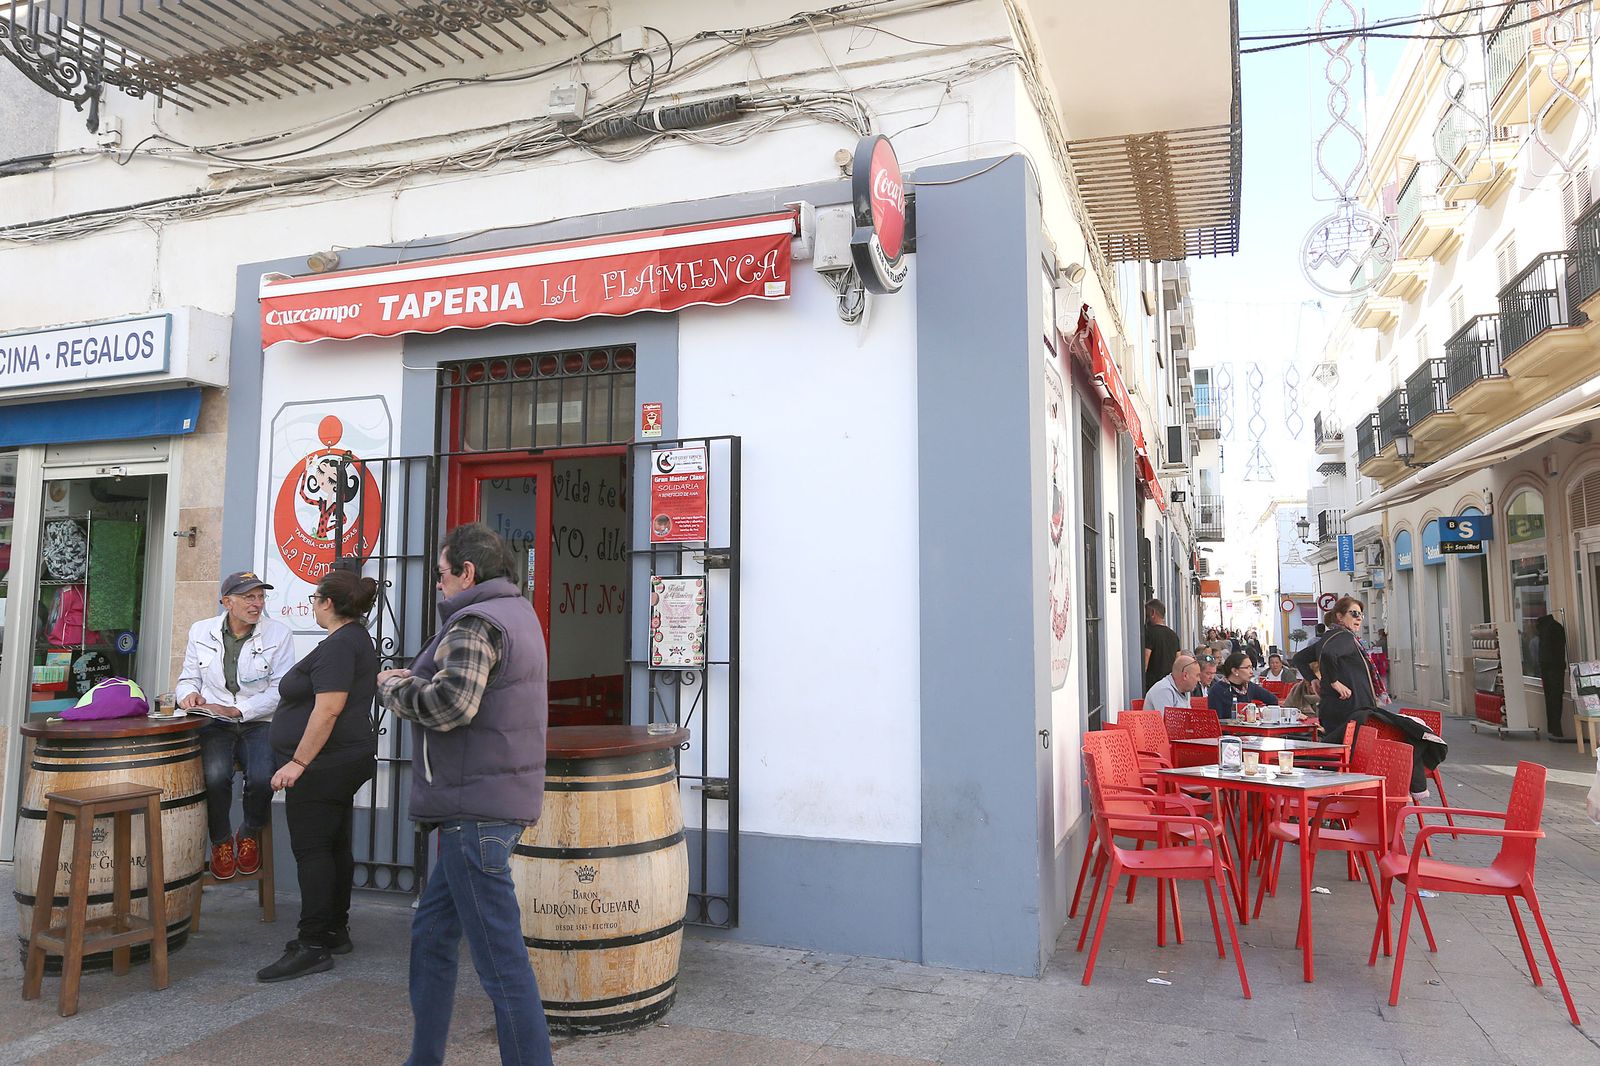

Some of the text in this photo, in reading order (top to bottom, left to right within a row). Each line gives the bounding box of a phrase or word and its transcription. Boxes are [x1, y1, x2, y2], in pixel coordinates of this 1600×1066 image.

[265, 249, 780, 326] Cruzcampo TAPERIA LA FLAMENCA
[56, 330, 154, 368] REGALOS
[552, 469, 590, 504] vida
[598, 479, 616, 508] te
[657, 483, 700, 492] SOLIDARIA
[342, 528, 358, 544] OPAS
[1448, 520, 1474, 539] B S
[279, 534, 298, 561] La
[281, 604, 294, 616] en
[560, 583, 588, 614] NI
[533, 898, 641, 918] LADRÓN DE GUEVARA
